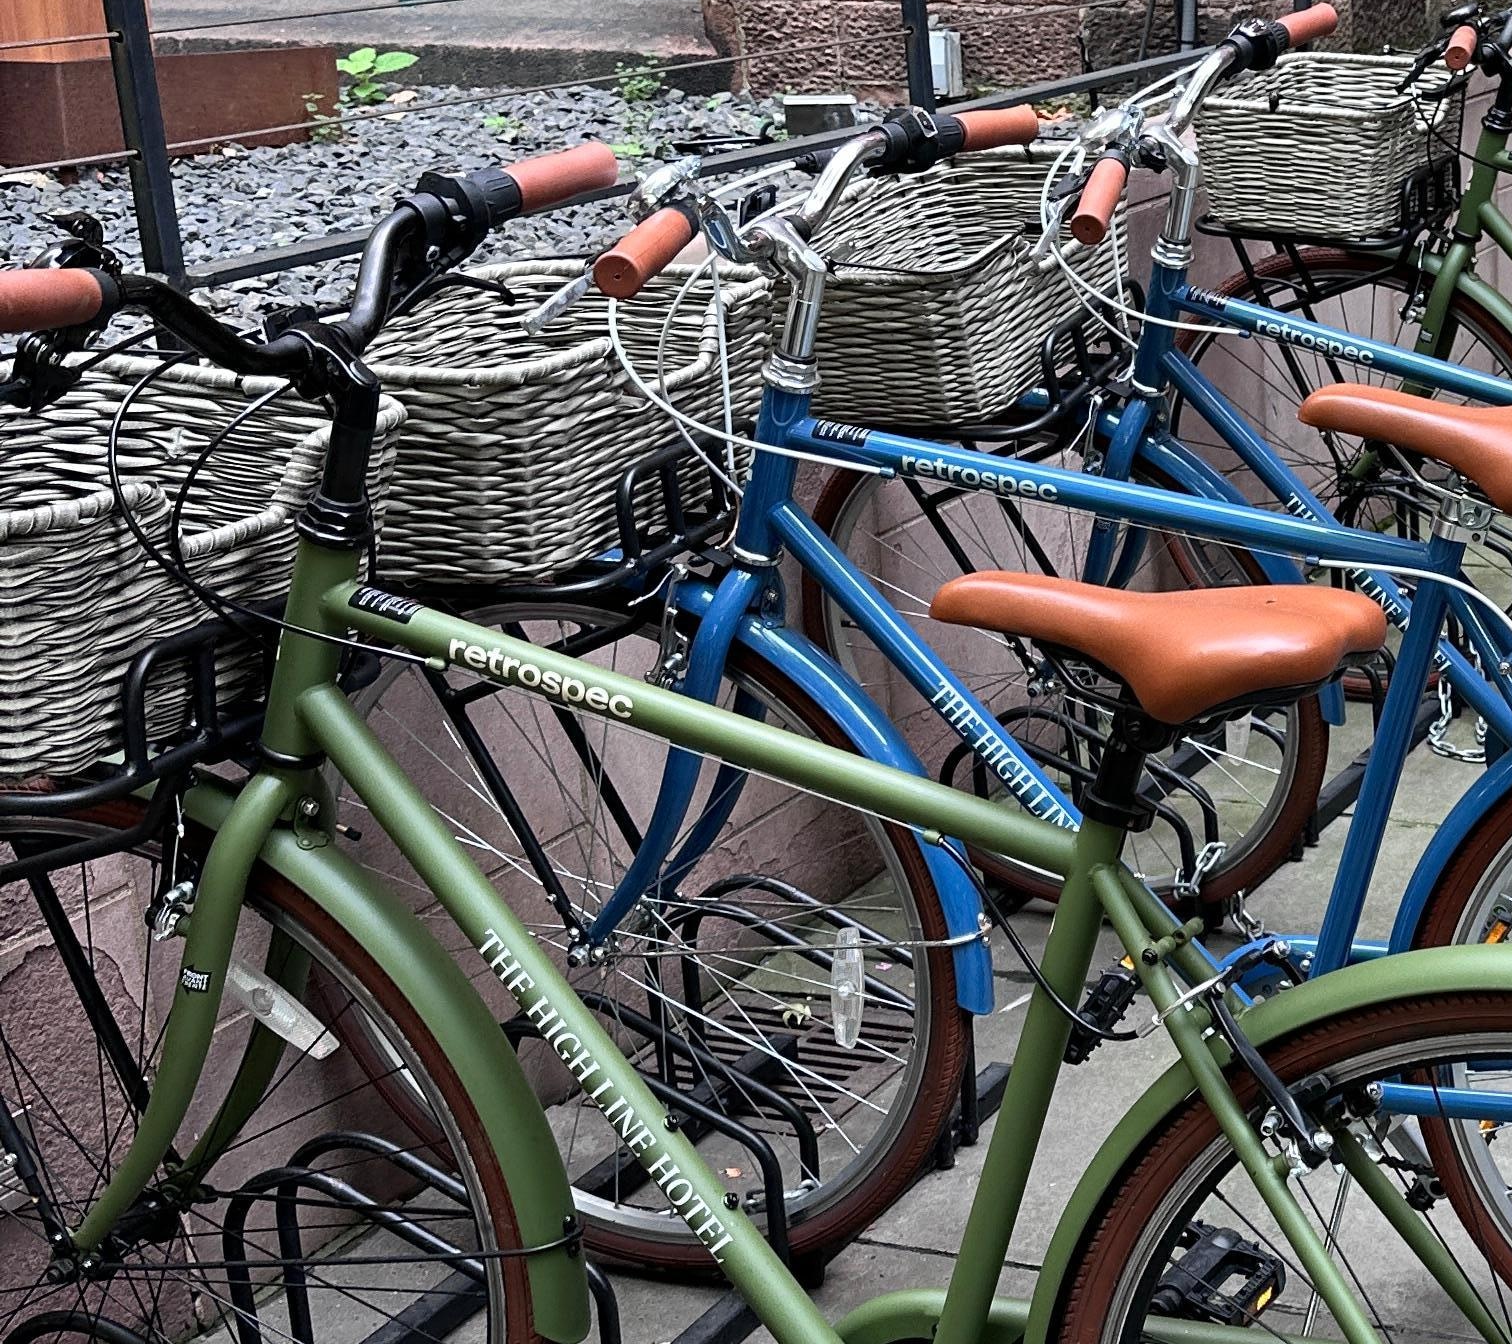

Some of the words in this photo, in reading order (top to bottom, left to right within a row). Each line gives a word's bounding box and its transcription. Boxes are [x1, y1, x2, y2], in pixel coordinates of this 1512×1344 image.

[1256, 319, 1375, 365] retrospec
[901, 455, 1058, 502] retrospec
[1286, 492, 1318, 521] TH
[450, 638, 633, 719] retrospec
[931, 679, 980, 736] THE
[974, 730, 1038, 797] HIGH
[1028, 791, 1081, 833] LIN
[480, 928, 537, 1002] THE
[527, 995, 600, 1083] HIGH
[590, 1077, 657, 1158] LINE
[647, 1153, 734, 1265] HOTEL
